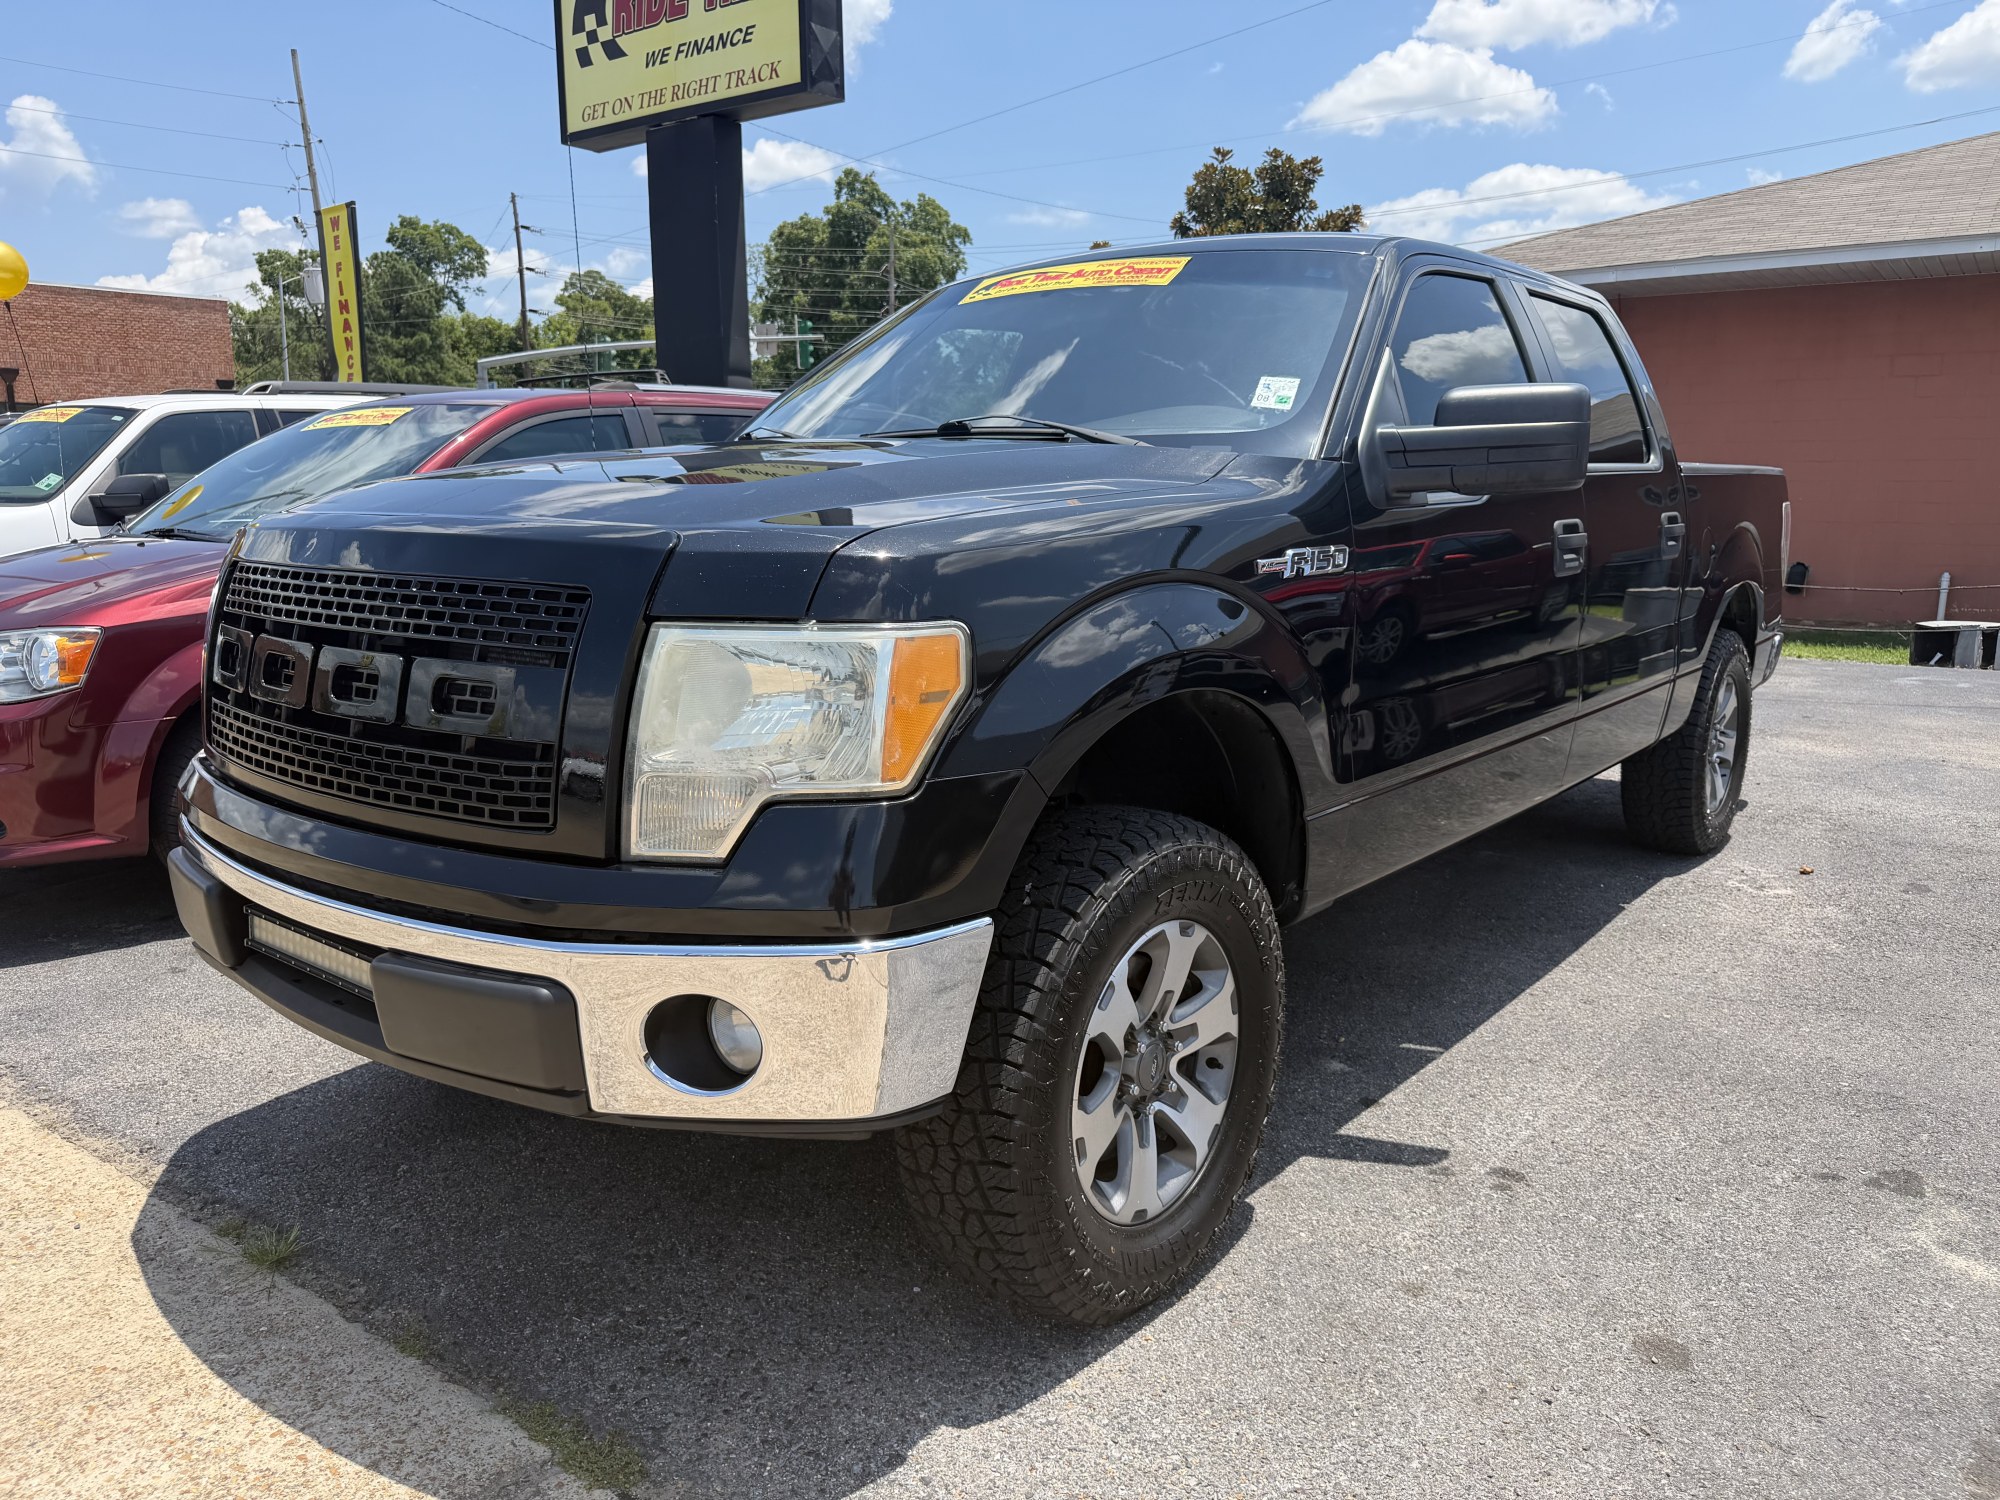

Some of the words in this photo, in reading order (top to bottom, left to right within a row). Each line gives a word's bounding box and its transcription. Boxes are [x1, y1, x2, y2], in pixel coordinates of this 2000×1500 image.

[645, 46, 672, 69] WE
[674, 24, 757, 62] FINANCE
[581, 101, 609, 123] GET
[612, 95, 635, 116] ON
[638, 87, 667, 110] THE
[670, 74, 722, 103] RIGHT
[725, 60, 782, 90] TRACK
[1064, 267, 1113, 280] AUTO
[1114, 265, 1178, 276] CREDIT
[1127, 259, 1181, 267] PROTECTION
[329, 215, 341, 251] WE
[335, 261, 354, 382] FINANCE
